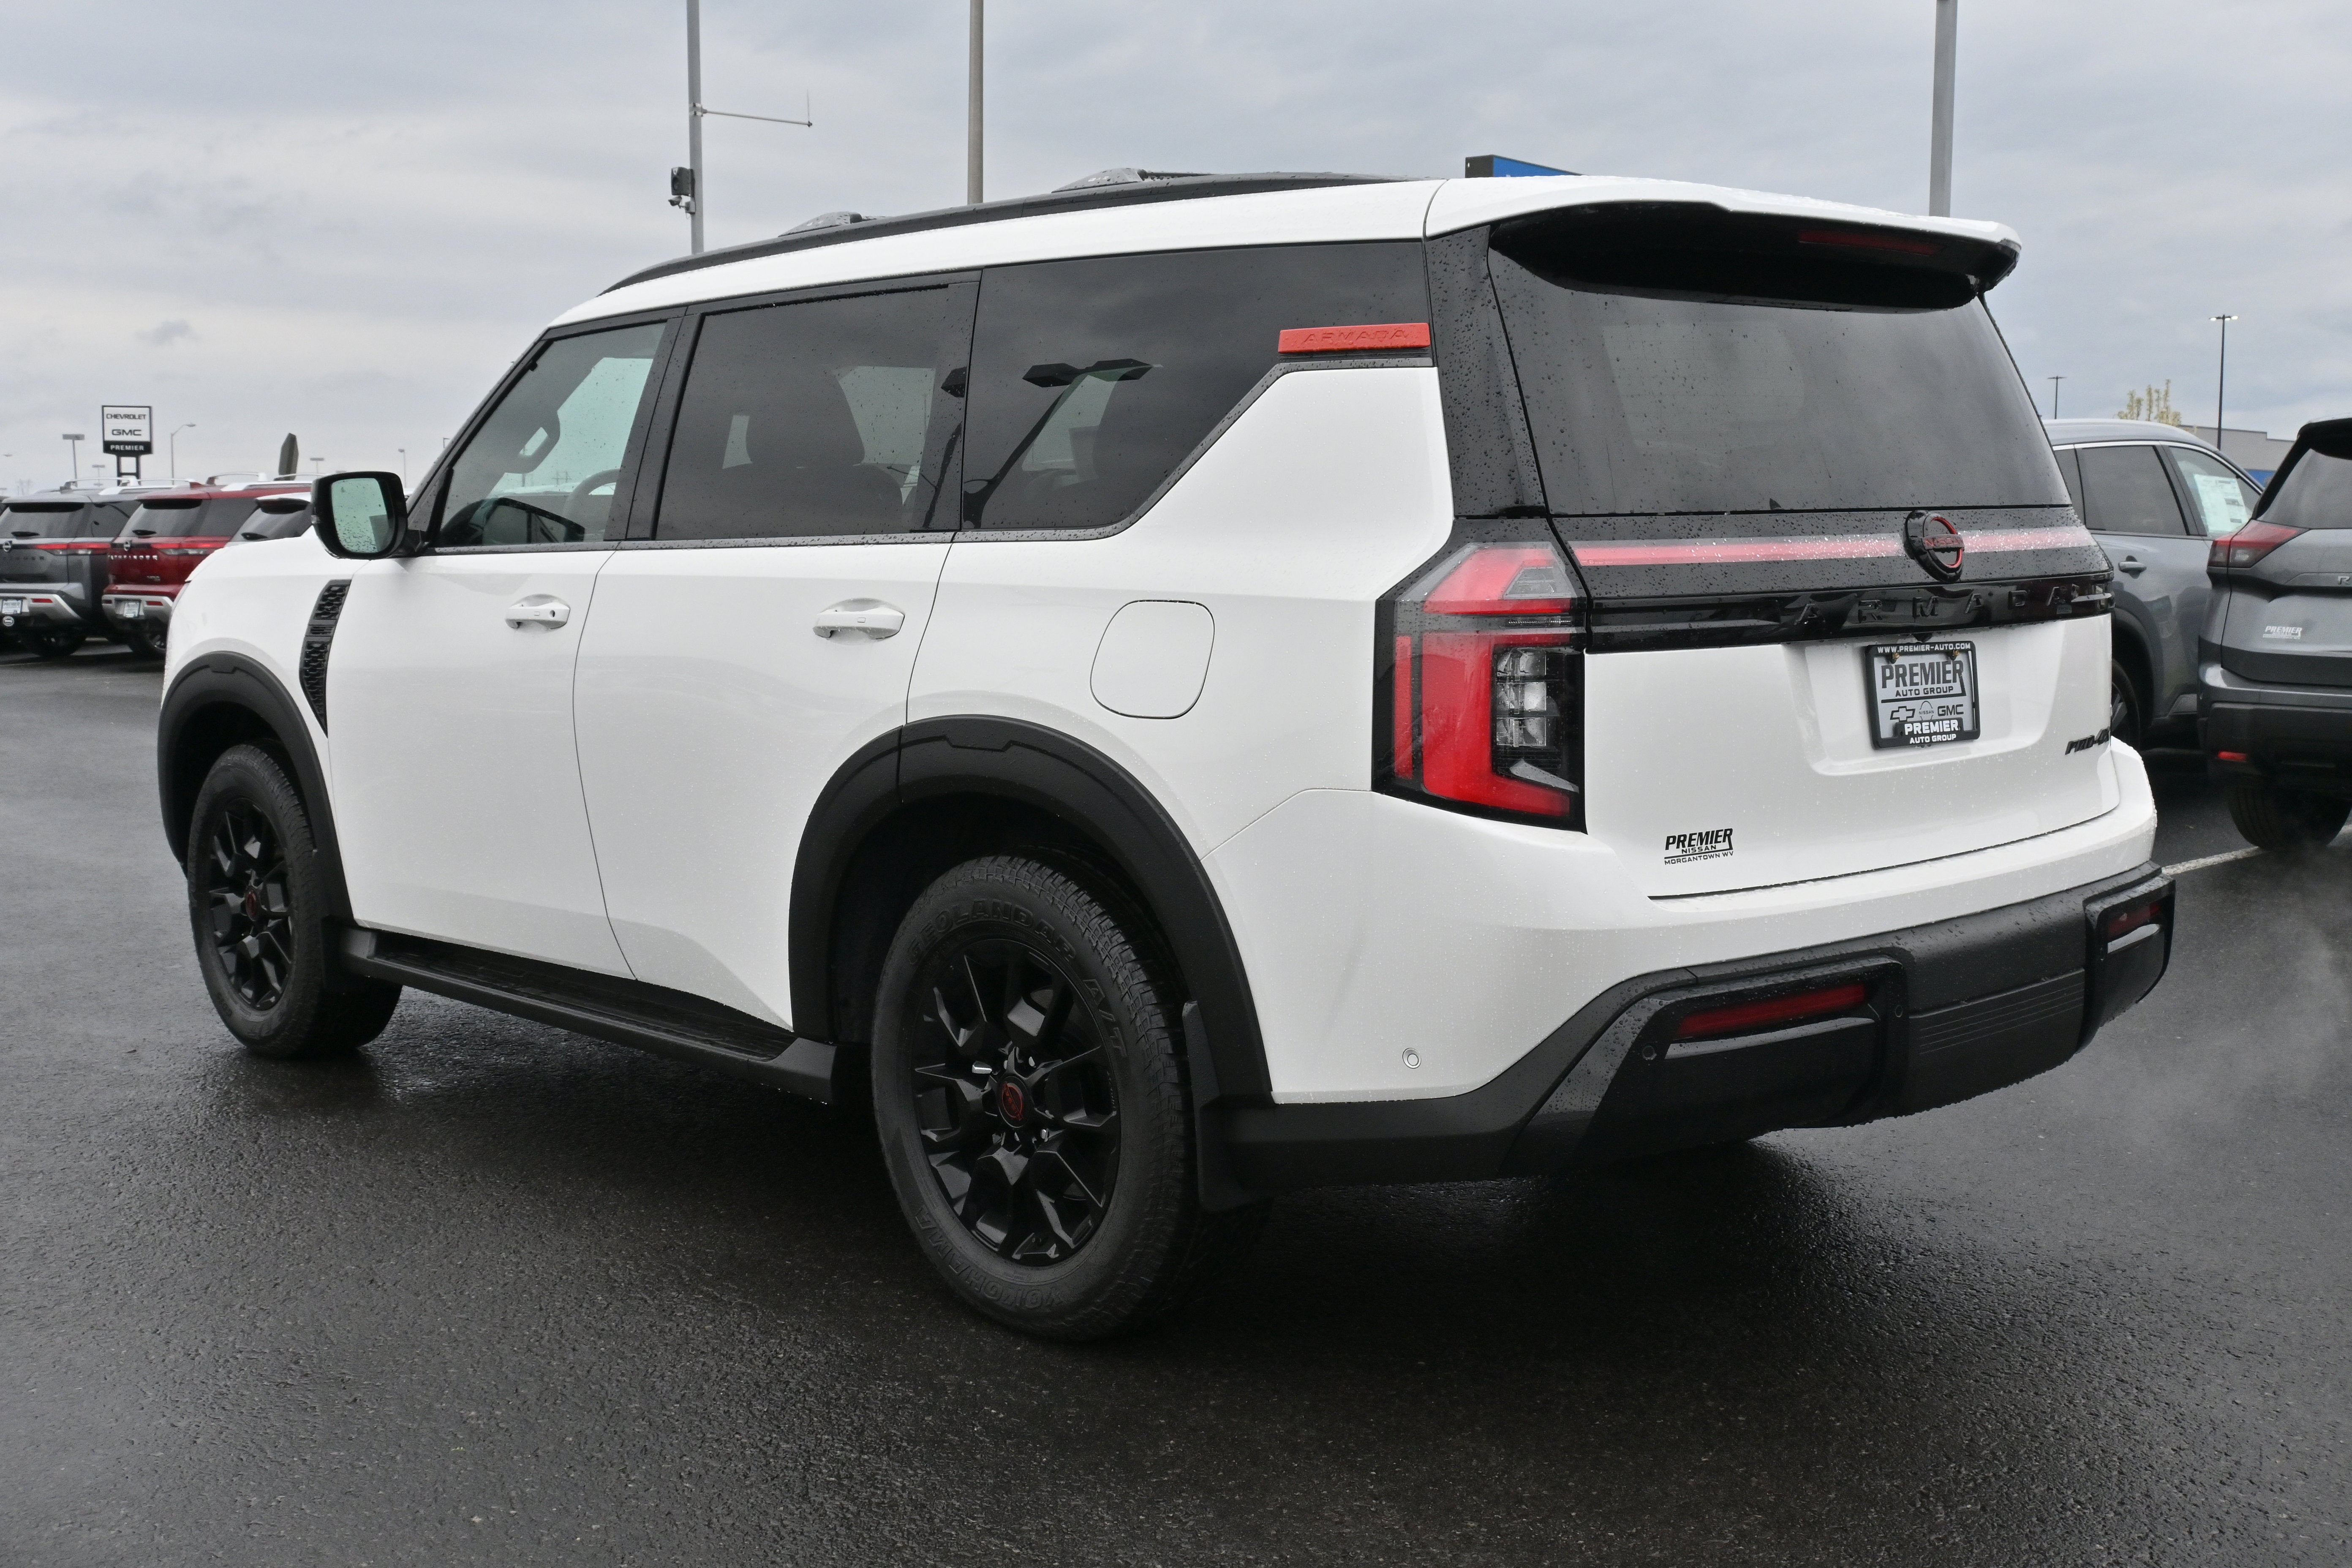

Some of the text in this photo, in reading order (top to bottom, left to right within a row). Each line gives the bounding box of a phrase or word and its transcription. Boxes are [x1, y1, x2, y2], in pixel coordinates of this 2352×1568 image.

[1301, 329, 1409, 345] ARMADA
[1794, 585, 2070, 626] ARMADA
[2265, 626, 2302, 634] PREMIER
[1877, 642, 1971, 653] WWW.PREMIER-AUTO.COM
[1881, 660, 1964, 689] PREMIER
[1895, 686, 1954, 697] AUTO GROUP
[1937, 704, 1964, 716] GMC
[1904, 719, 1959, 735] PREMIER
[1932, 734, 1957, 742] GROUP
[1665, 828, 1733, 850] PREMIER
[1681, 845, 1716, 854] NISSAN
[1664, 853, 1720, 865] MORGANTOWN
[908, 897, 1076, 965] GEOLANDAR
[914, 1204, 1063, 1310] YOKOHAMA
